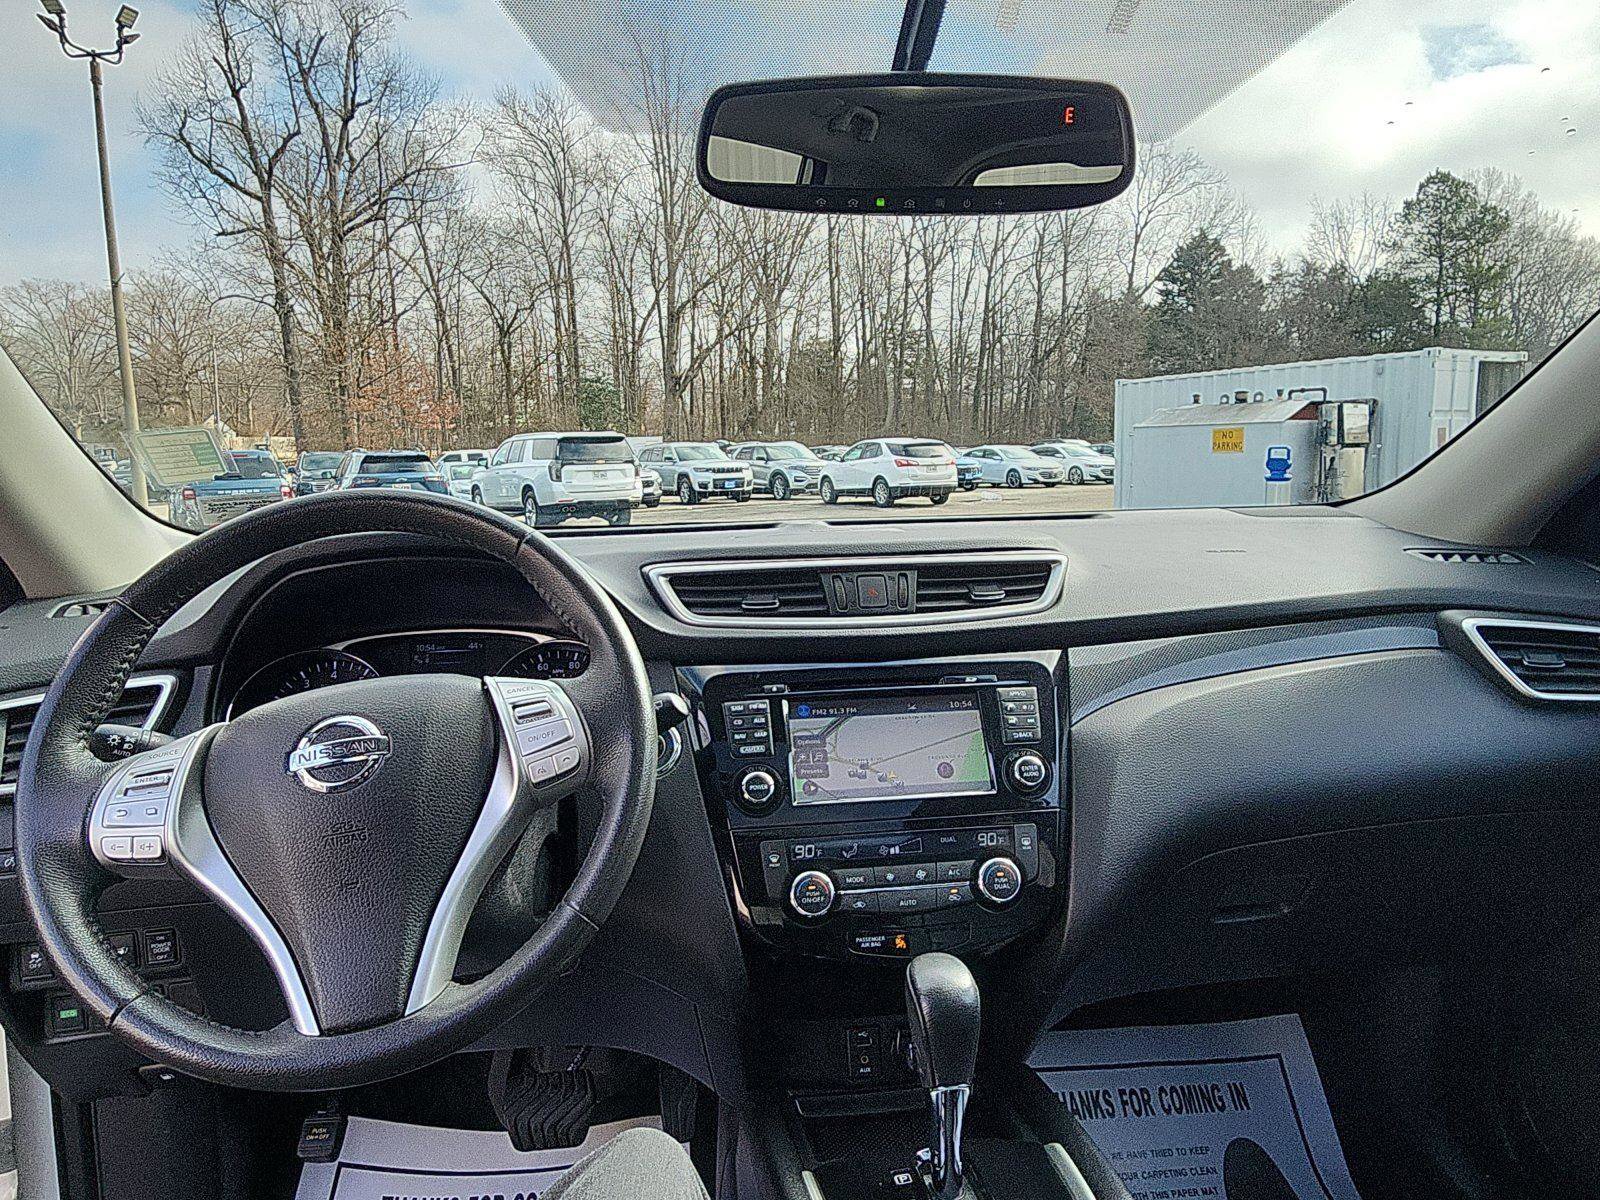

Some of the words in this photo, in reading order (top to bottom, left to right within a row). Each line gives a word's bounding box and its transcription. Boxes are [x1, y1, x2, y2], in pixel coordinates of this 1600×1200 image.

[1065, 107, 1075, 124] E
[1221, 431, 1234, 439] NO
[1212, 441, 1243, 450] PARKING
[568, 661, 581, 669] 80
[304, 680, 310, 688] 3
[507, 686, 535, 694] CANCEL
[528, 730, 556, 743] ON/OFF
[113, 748, 131, 757] AUTO
[298, 740, 378, 765] NISSAN
[1059, 1090, 1116, 1120] ANKS
[1117, 1087, 1155, 1118] FOR
[1157, 1083, 1226, 1115] COMING
[1227, 1082, 1251, 1111] IN
[1150, 1149, 1174, 1159] TRIED
[1176, 1147, 1188, 1157] TO
[1189, 1146, 1210, 1156] KEEP
[1141, 1168, 1188, 1181] CARPETING
[1190, 1166, 1218, 1177] CLEAN
[1151, 1190, 1170, 1200] THIS
[1171, 1188, 1200, 1198] PAPER
[1201, 1187, 1219, 1196] MAT
